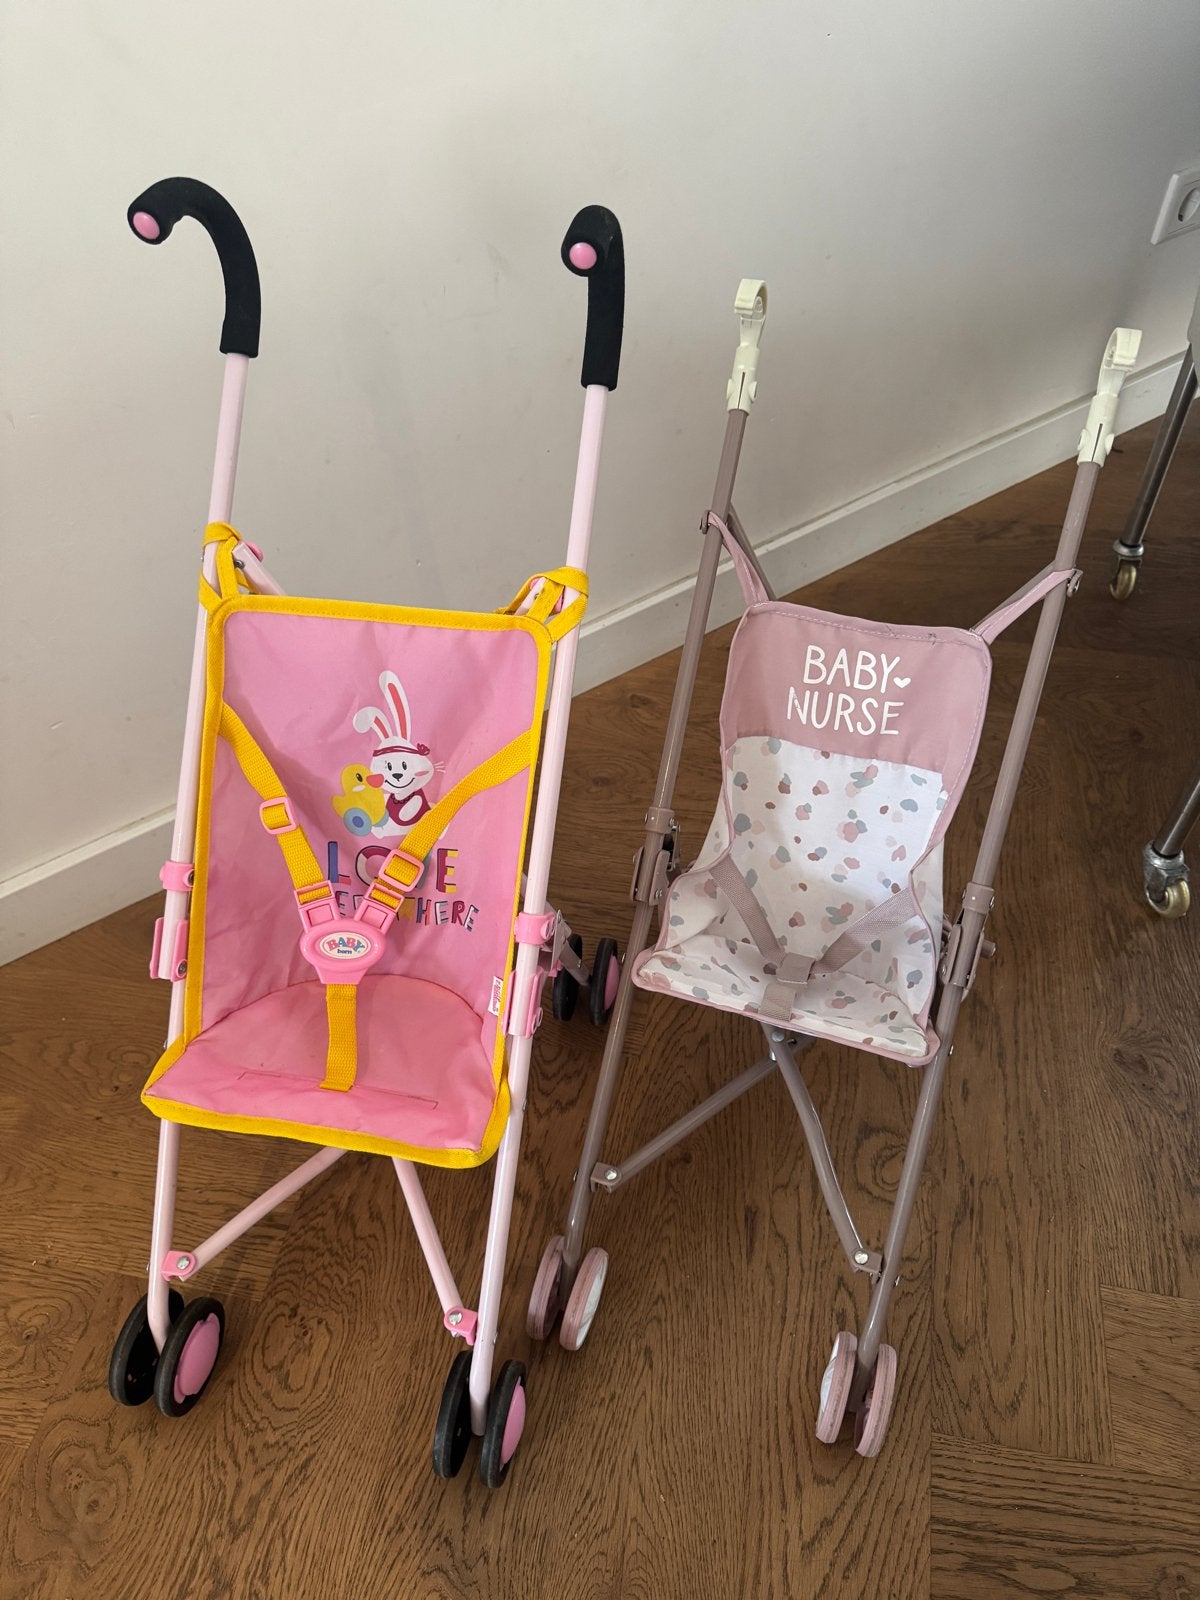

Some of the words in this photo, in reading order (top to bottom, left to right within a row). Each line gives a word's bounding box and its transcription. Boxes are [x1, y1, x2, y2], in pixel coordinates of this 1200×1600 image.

[803, 644, 900, 694] BABY
[786, 686, 905, 736] NURSE
[327, 840, 459, 894] LOE
[326, 936, 366, 952] BABY
